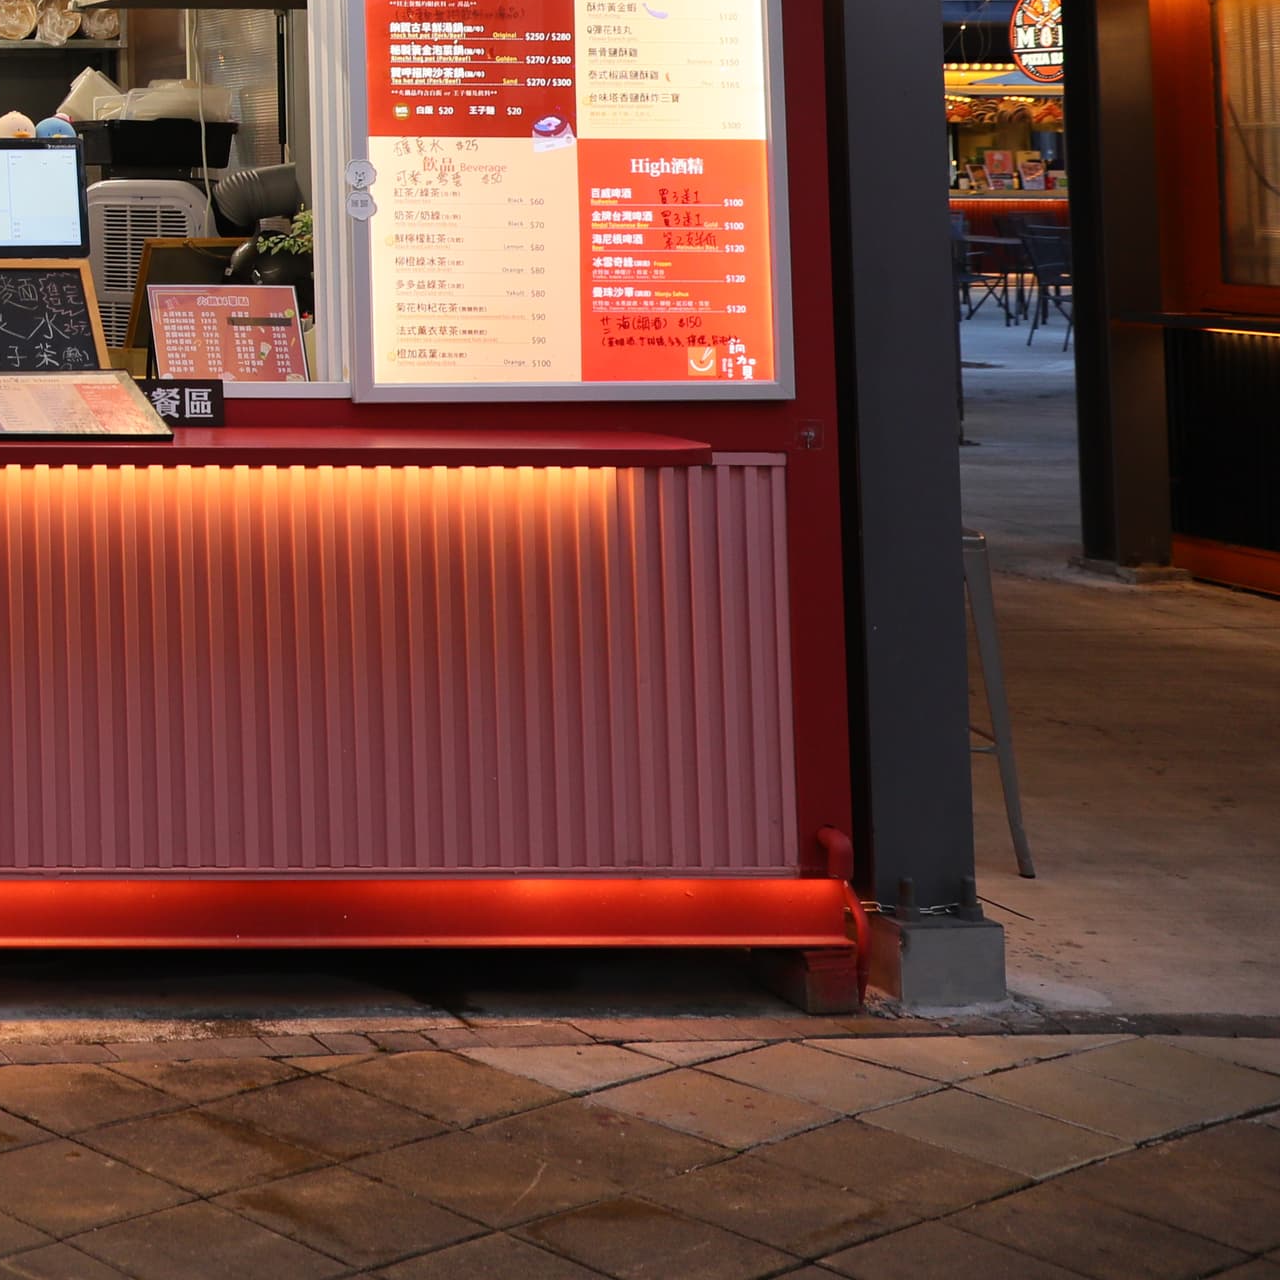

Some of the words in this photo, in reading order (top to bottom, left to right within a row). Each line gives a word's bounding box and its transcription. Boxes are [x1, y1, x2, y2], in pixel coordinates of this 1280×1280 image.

[525, 32, 545, 41] $250
[551, 32, 571, 41] $280
[526, 56, 545, 64] $270
[551, 56, 572, 64] $300
[526, 78, 546, 86] $270
[552, 78, 572, 86] $300
[438, 106, 454, 115] $20
[507, 107, 522, 116] $20
[456, 139, 479, 152] $25
[423, 156, 455, 173] 飲品
[460, 163, 507, 173] Beverage
[630, 157, 704, 177] High酒精
[481, 174, 502, 185] $50
[591, 188, 632, 199] 百威啤酒
[530, 198, 545, 206] $60
[723, 199, 743, 207] $100
[530, 221, 545, 230] $70
[724, 222, 744, 230] $100
[725, 245, 744, 253] $120
[726, 274, 746, 283] $120
[531, 290, 545, 298] $80
[727, 305, 746, 313] $120
[531, 313, 546, 321] $90
[531, 336, 546, 345] $90
[532, 359, 551, 368] $100
[145, 388, 213, 418] 餐區
